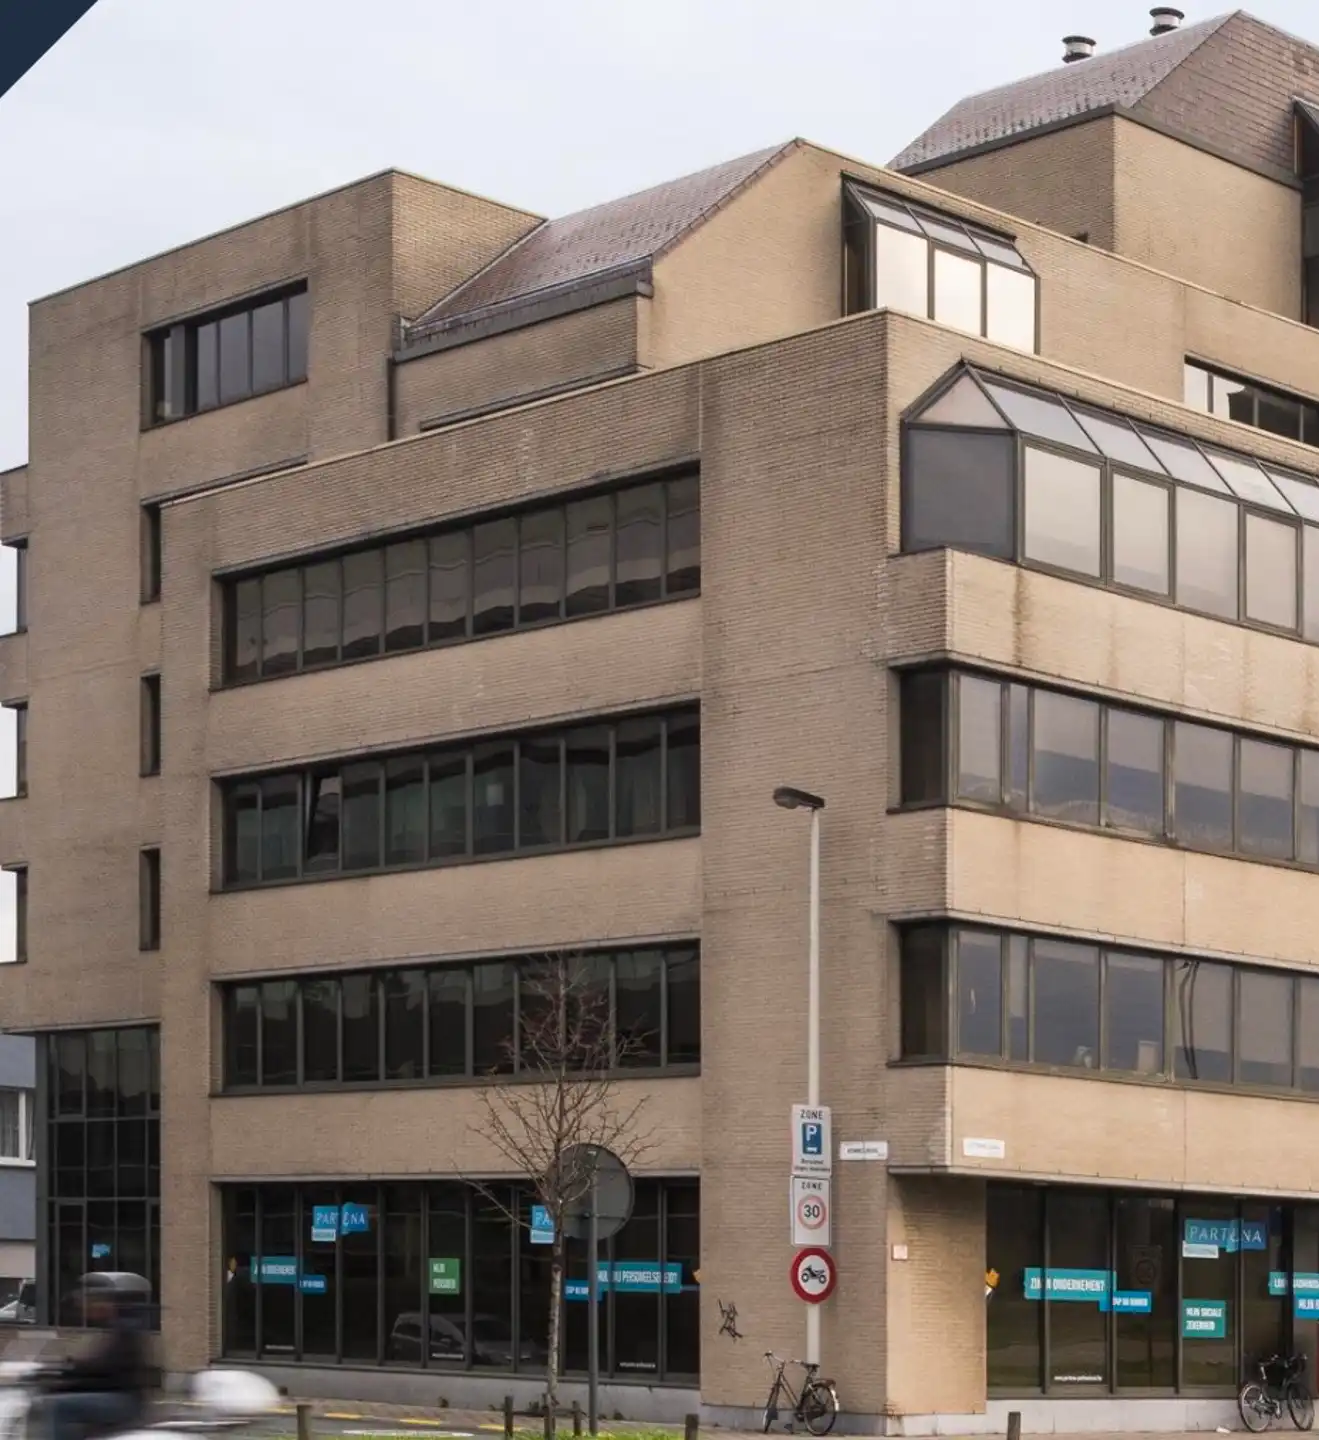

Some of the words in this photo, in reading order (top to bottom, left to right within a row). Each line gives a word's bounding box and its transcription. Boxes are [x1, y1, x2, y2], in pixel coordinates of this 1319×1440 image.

[800, 1109, 822, 1120] ZONE
[801, 1182, 823, 1190] ZONE
[803, 1205, 820, 1218] 30
